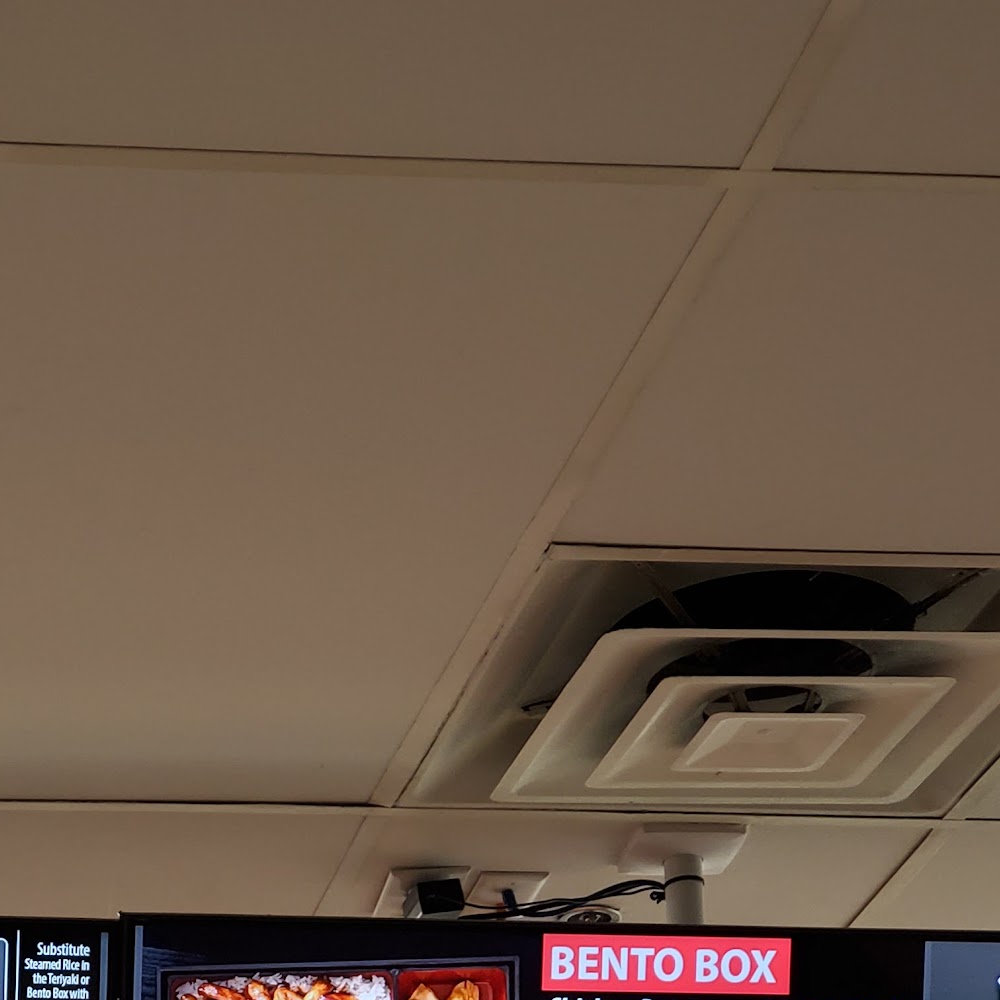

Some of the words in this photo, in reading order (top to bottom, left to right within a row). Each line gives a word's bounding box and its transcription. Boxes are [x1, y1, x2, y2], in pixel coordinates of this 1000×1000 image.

[37, 942, 90, 956] Substitute
[24, 958, 60, 970] Steamed
[62, 959, 79, 971] Rice
[82, 960, 90, 971] in
[551, 946, 683, 981] BENTO
[696, 949, 777, 983] BOX
